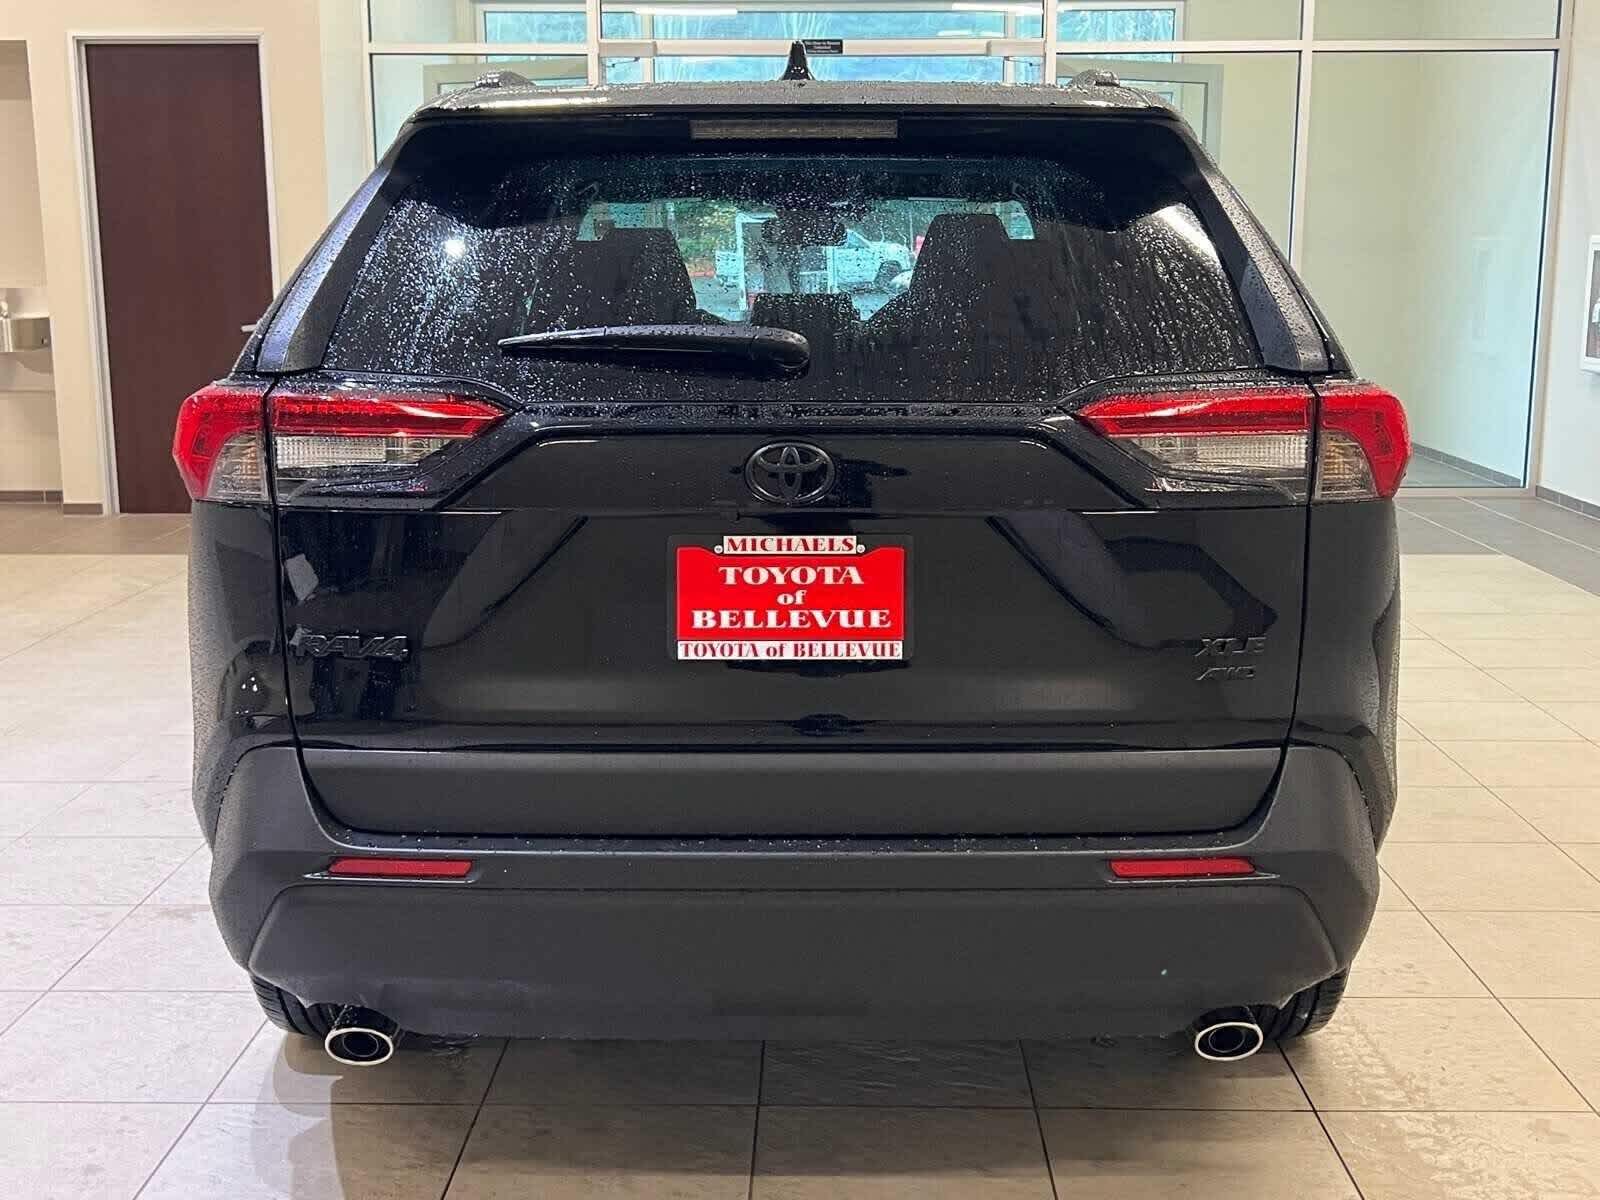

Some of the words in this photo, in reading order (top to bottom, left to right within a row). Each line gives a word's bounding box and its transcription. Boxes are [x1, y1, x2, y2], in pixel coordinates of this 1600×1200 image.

[726, 537, 855, 552] MICHAELS
[718, 566, 865, 585] TOYOTA
[776, 589, 807, 605] of
[691, 609, 892, 629] BELLEVUE
[298, 634, 409, 658] RAV4
[680, 642, 760, 658] TOYOTA
[765, 642, 787, 658] of
[793, 642, 901, 658] BELLEVUE
[1195, 636, 1267, 656] XLE
